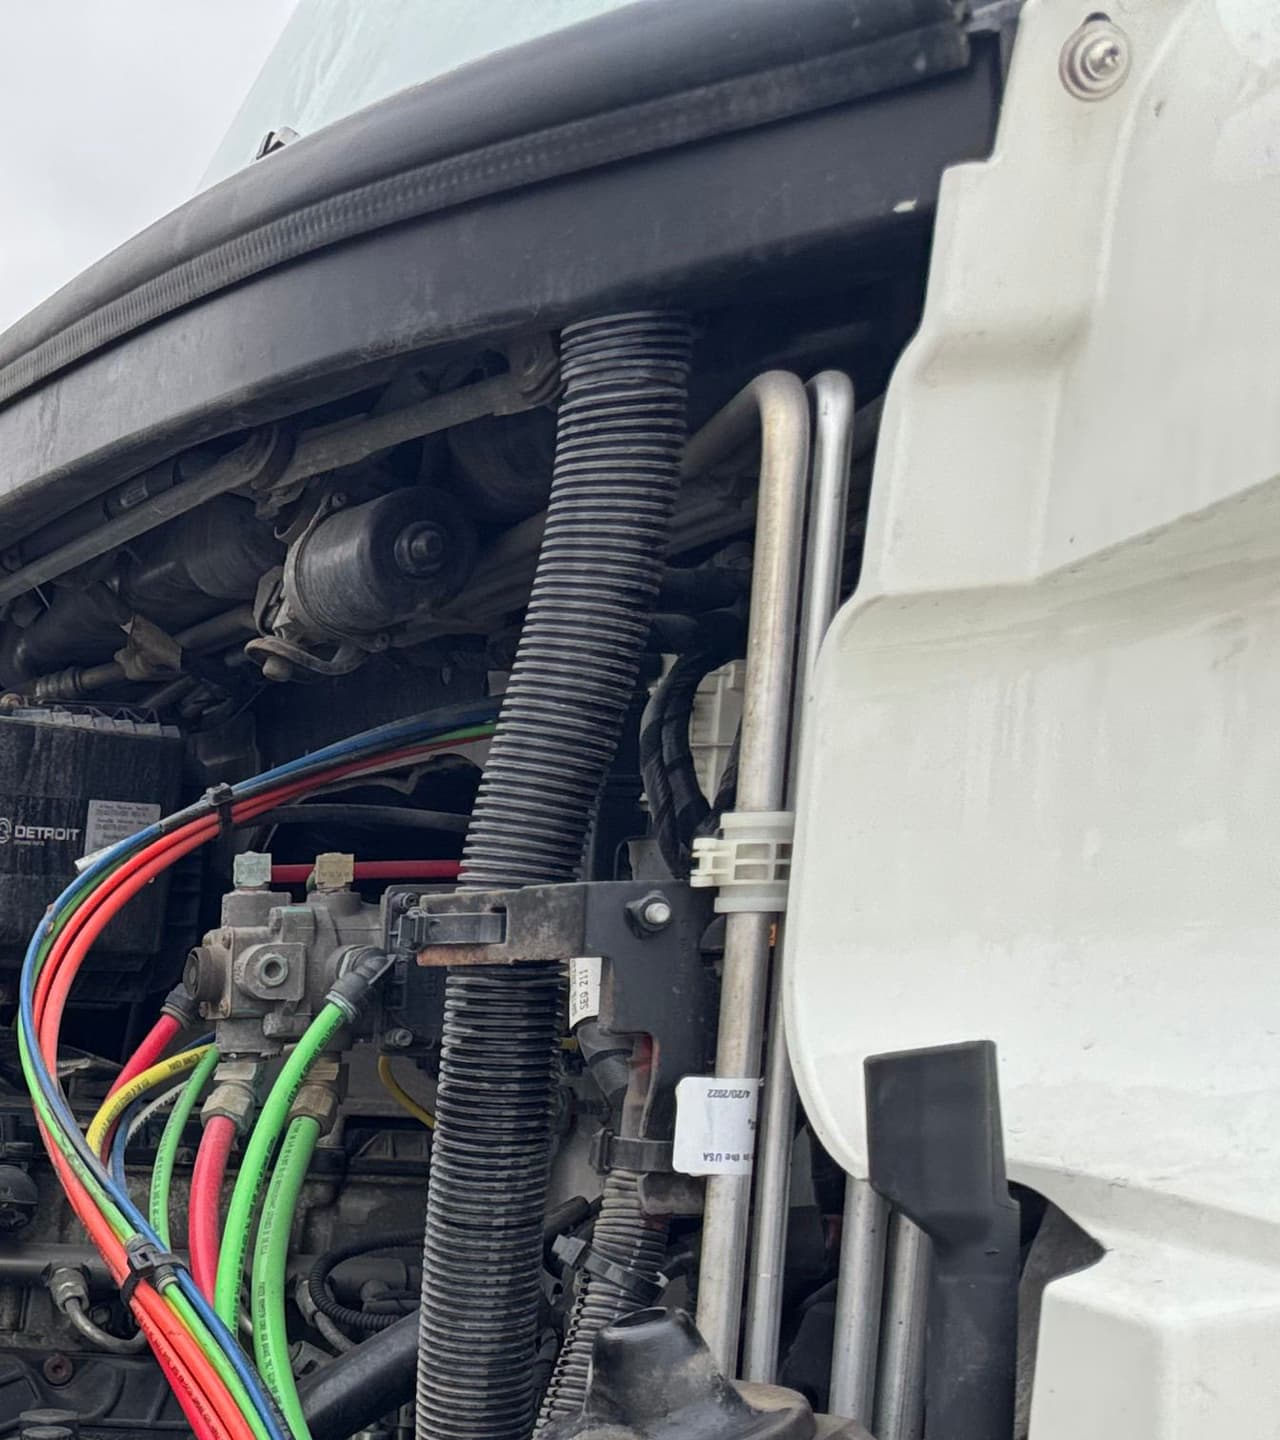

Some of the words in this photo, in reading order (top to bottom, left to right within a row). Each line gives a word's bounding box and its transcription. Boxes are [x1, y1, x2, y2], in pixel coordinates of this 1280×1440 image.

[14, 825, 80, 841] DETROIT
[703, 1152, 722, 1162] USA
[725, 1153, 740, 1162] the
